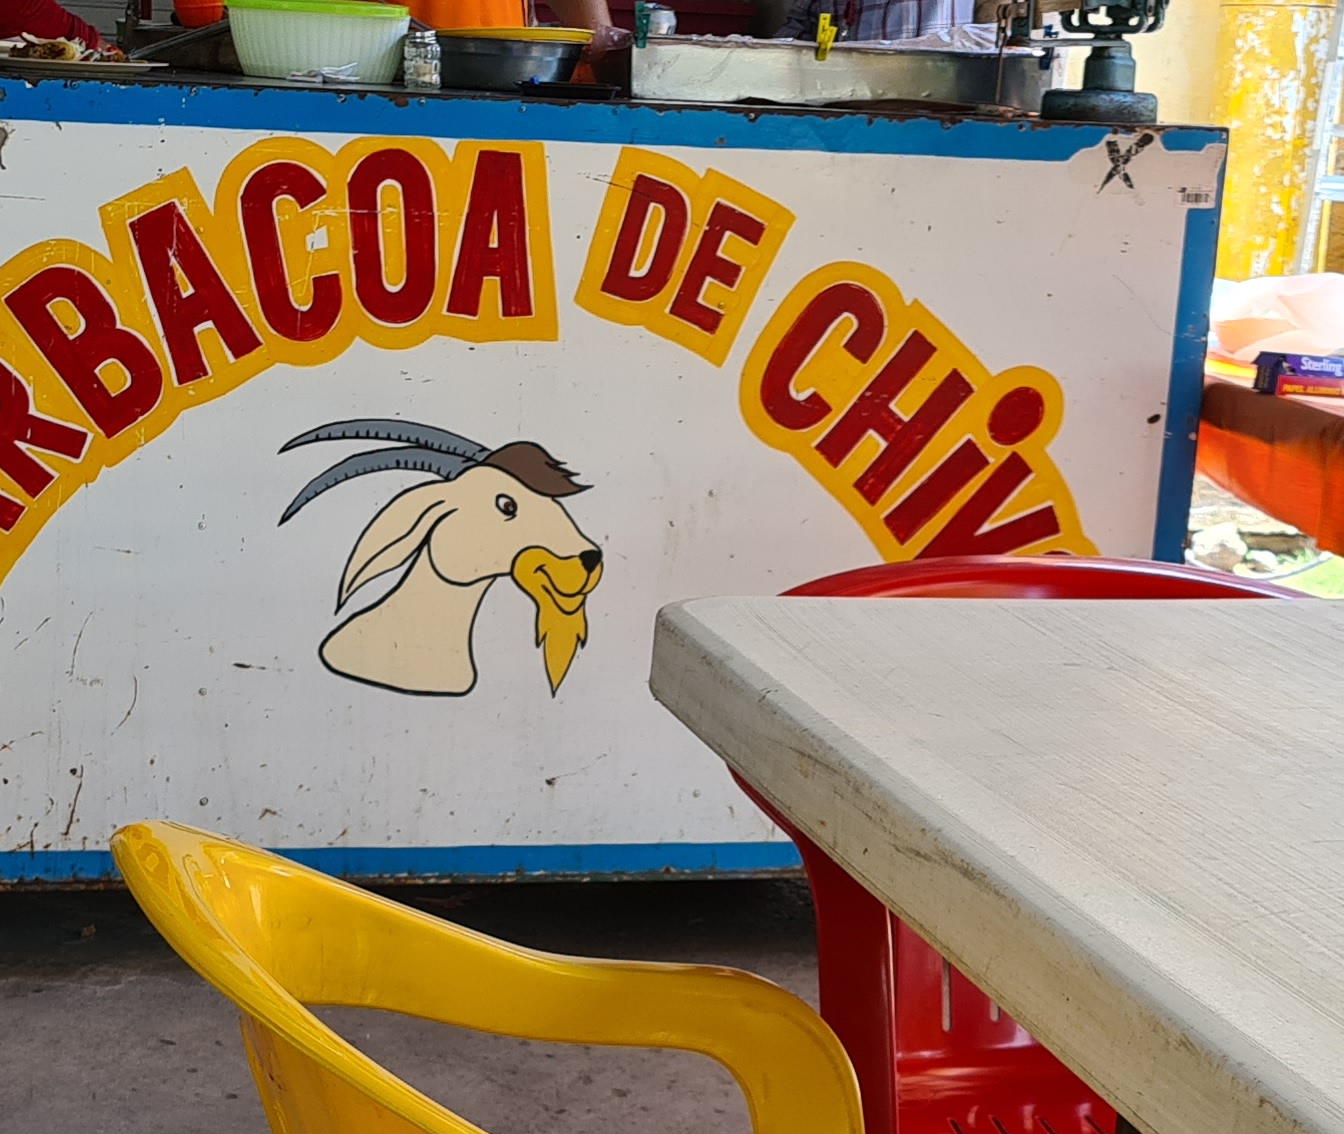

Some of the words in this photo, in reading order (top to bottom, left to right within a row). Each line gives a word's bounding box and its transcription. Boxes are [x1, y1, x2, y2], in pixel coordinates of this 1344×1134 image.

[599, 173, 766, 335] DE
[759, 281, 1074, 559] CHiV
[1300, 356, 1344, 377] Sterling
